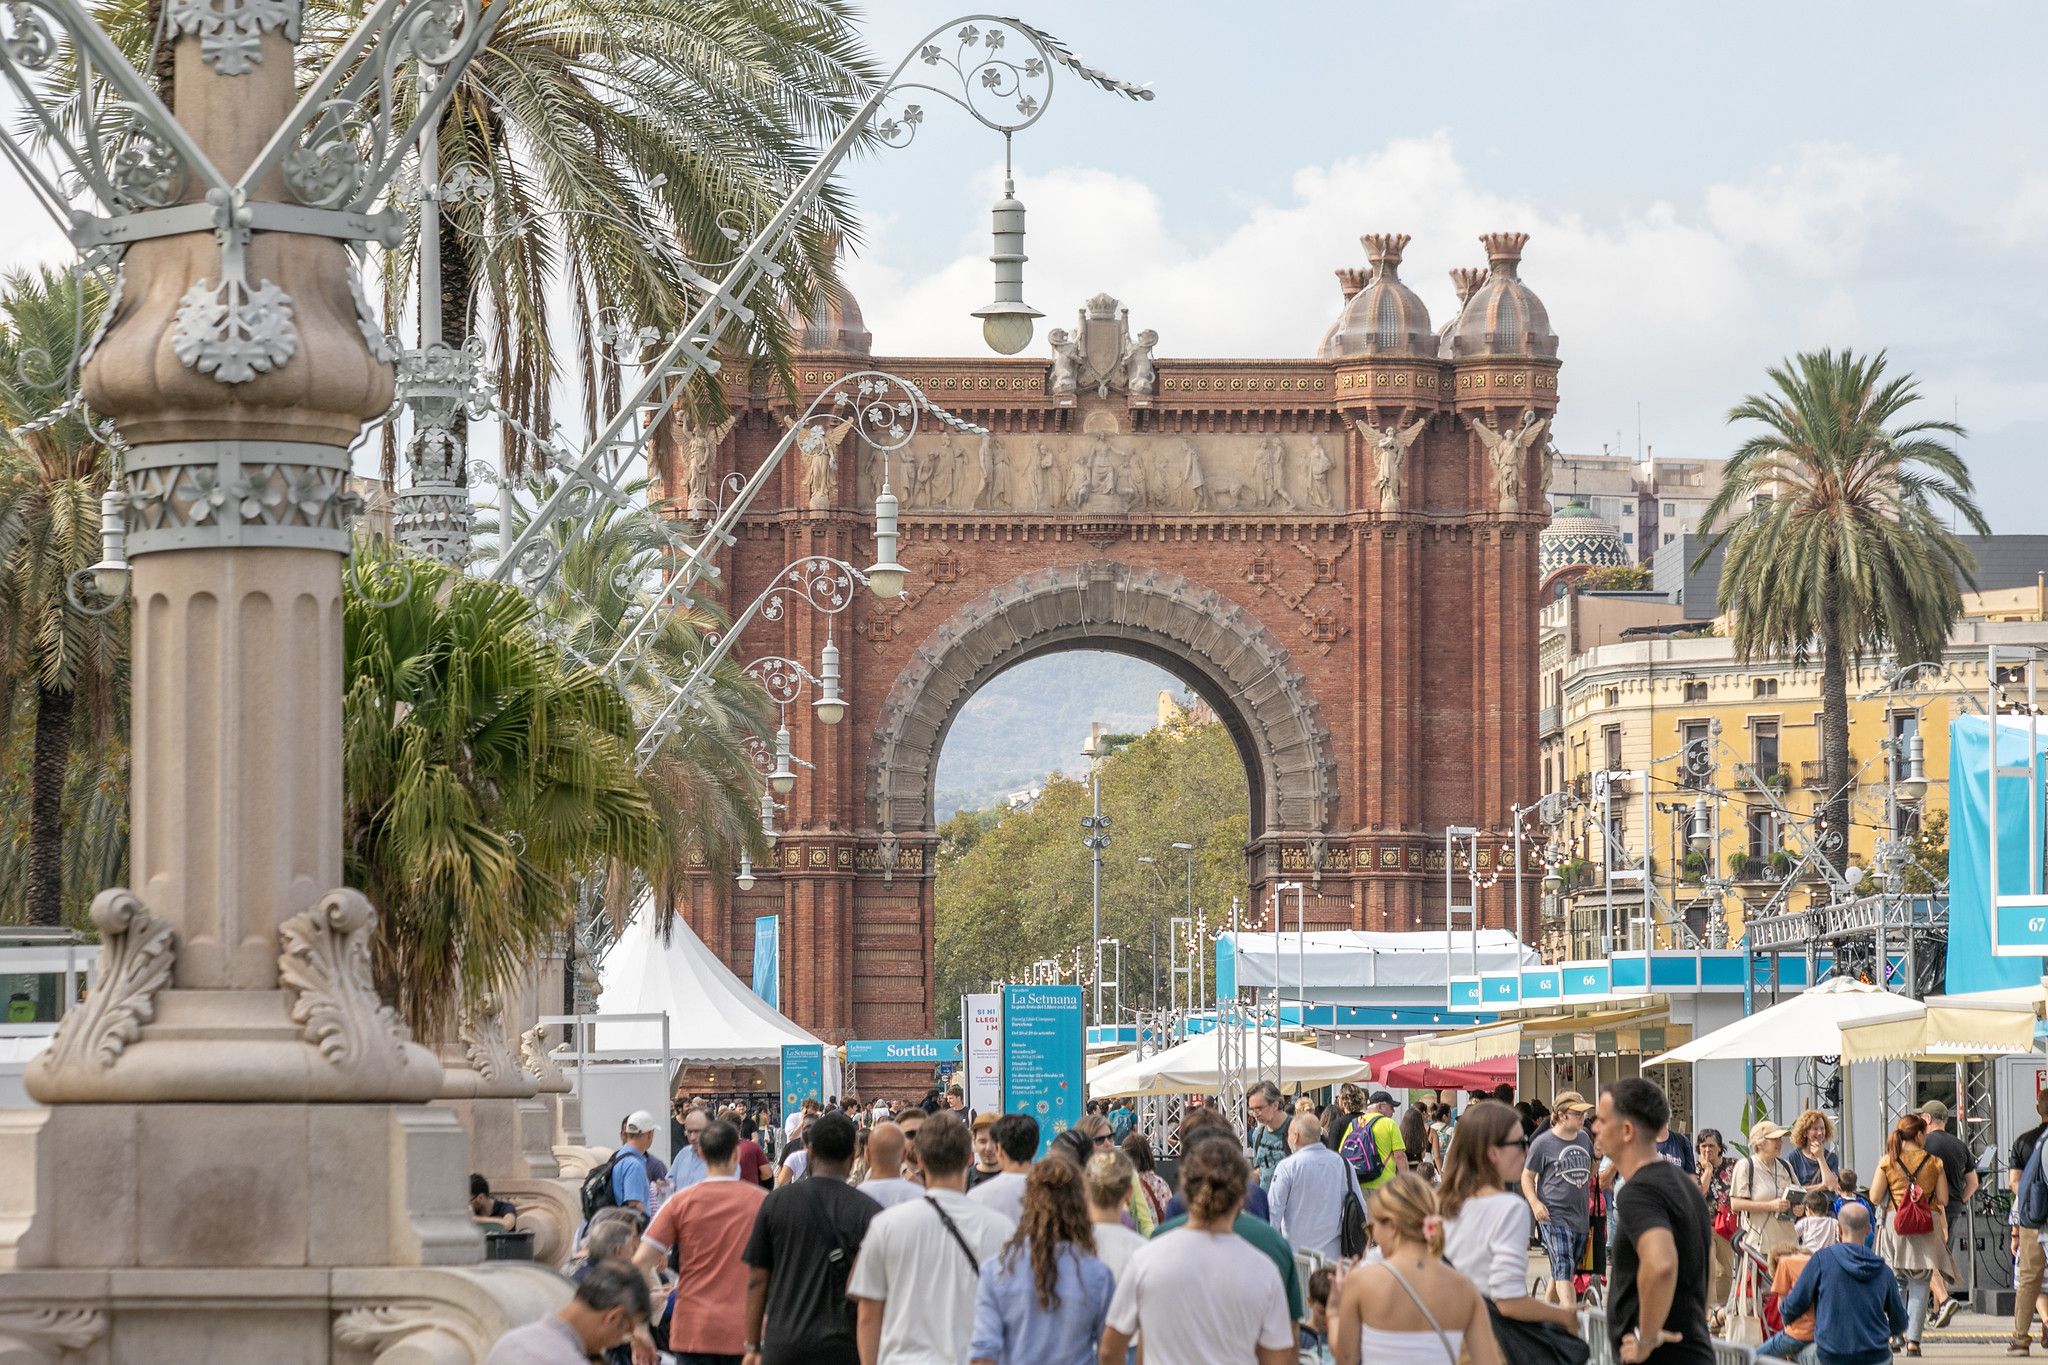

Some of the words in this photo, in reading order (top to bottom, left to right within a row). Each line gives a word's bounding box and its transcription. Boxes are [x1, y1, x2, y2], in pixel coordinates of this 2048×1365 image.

[2028, 917, 2046, 932] 67
[1540, 979, 1551, 989] 65
[1583, 975, 1595, 985] 66
[1468, 988, 1479, 997] 63
[1499, 984, 1510, 993] 64
[1011, 993, 1025, 1004] La
[1028, 992, 1077, 1004] Setmana
[887, 1044, 937, 1057] Sortida
